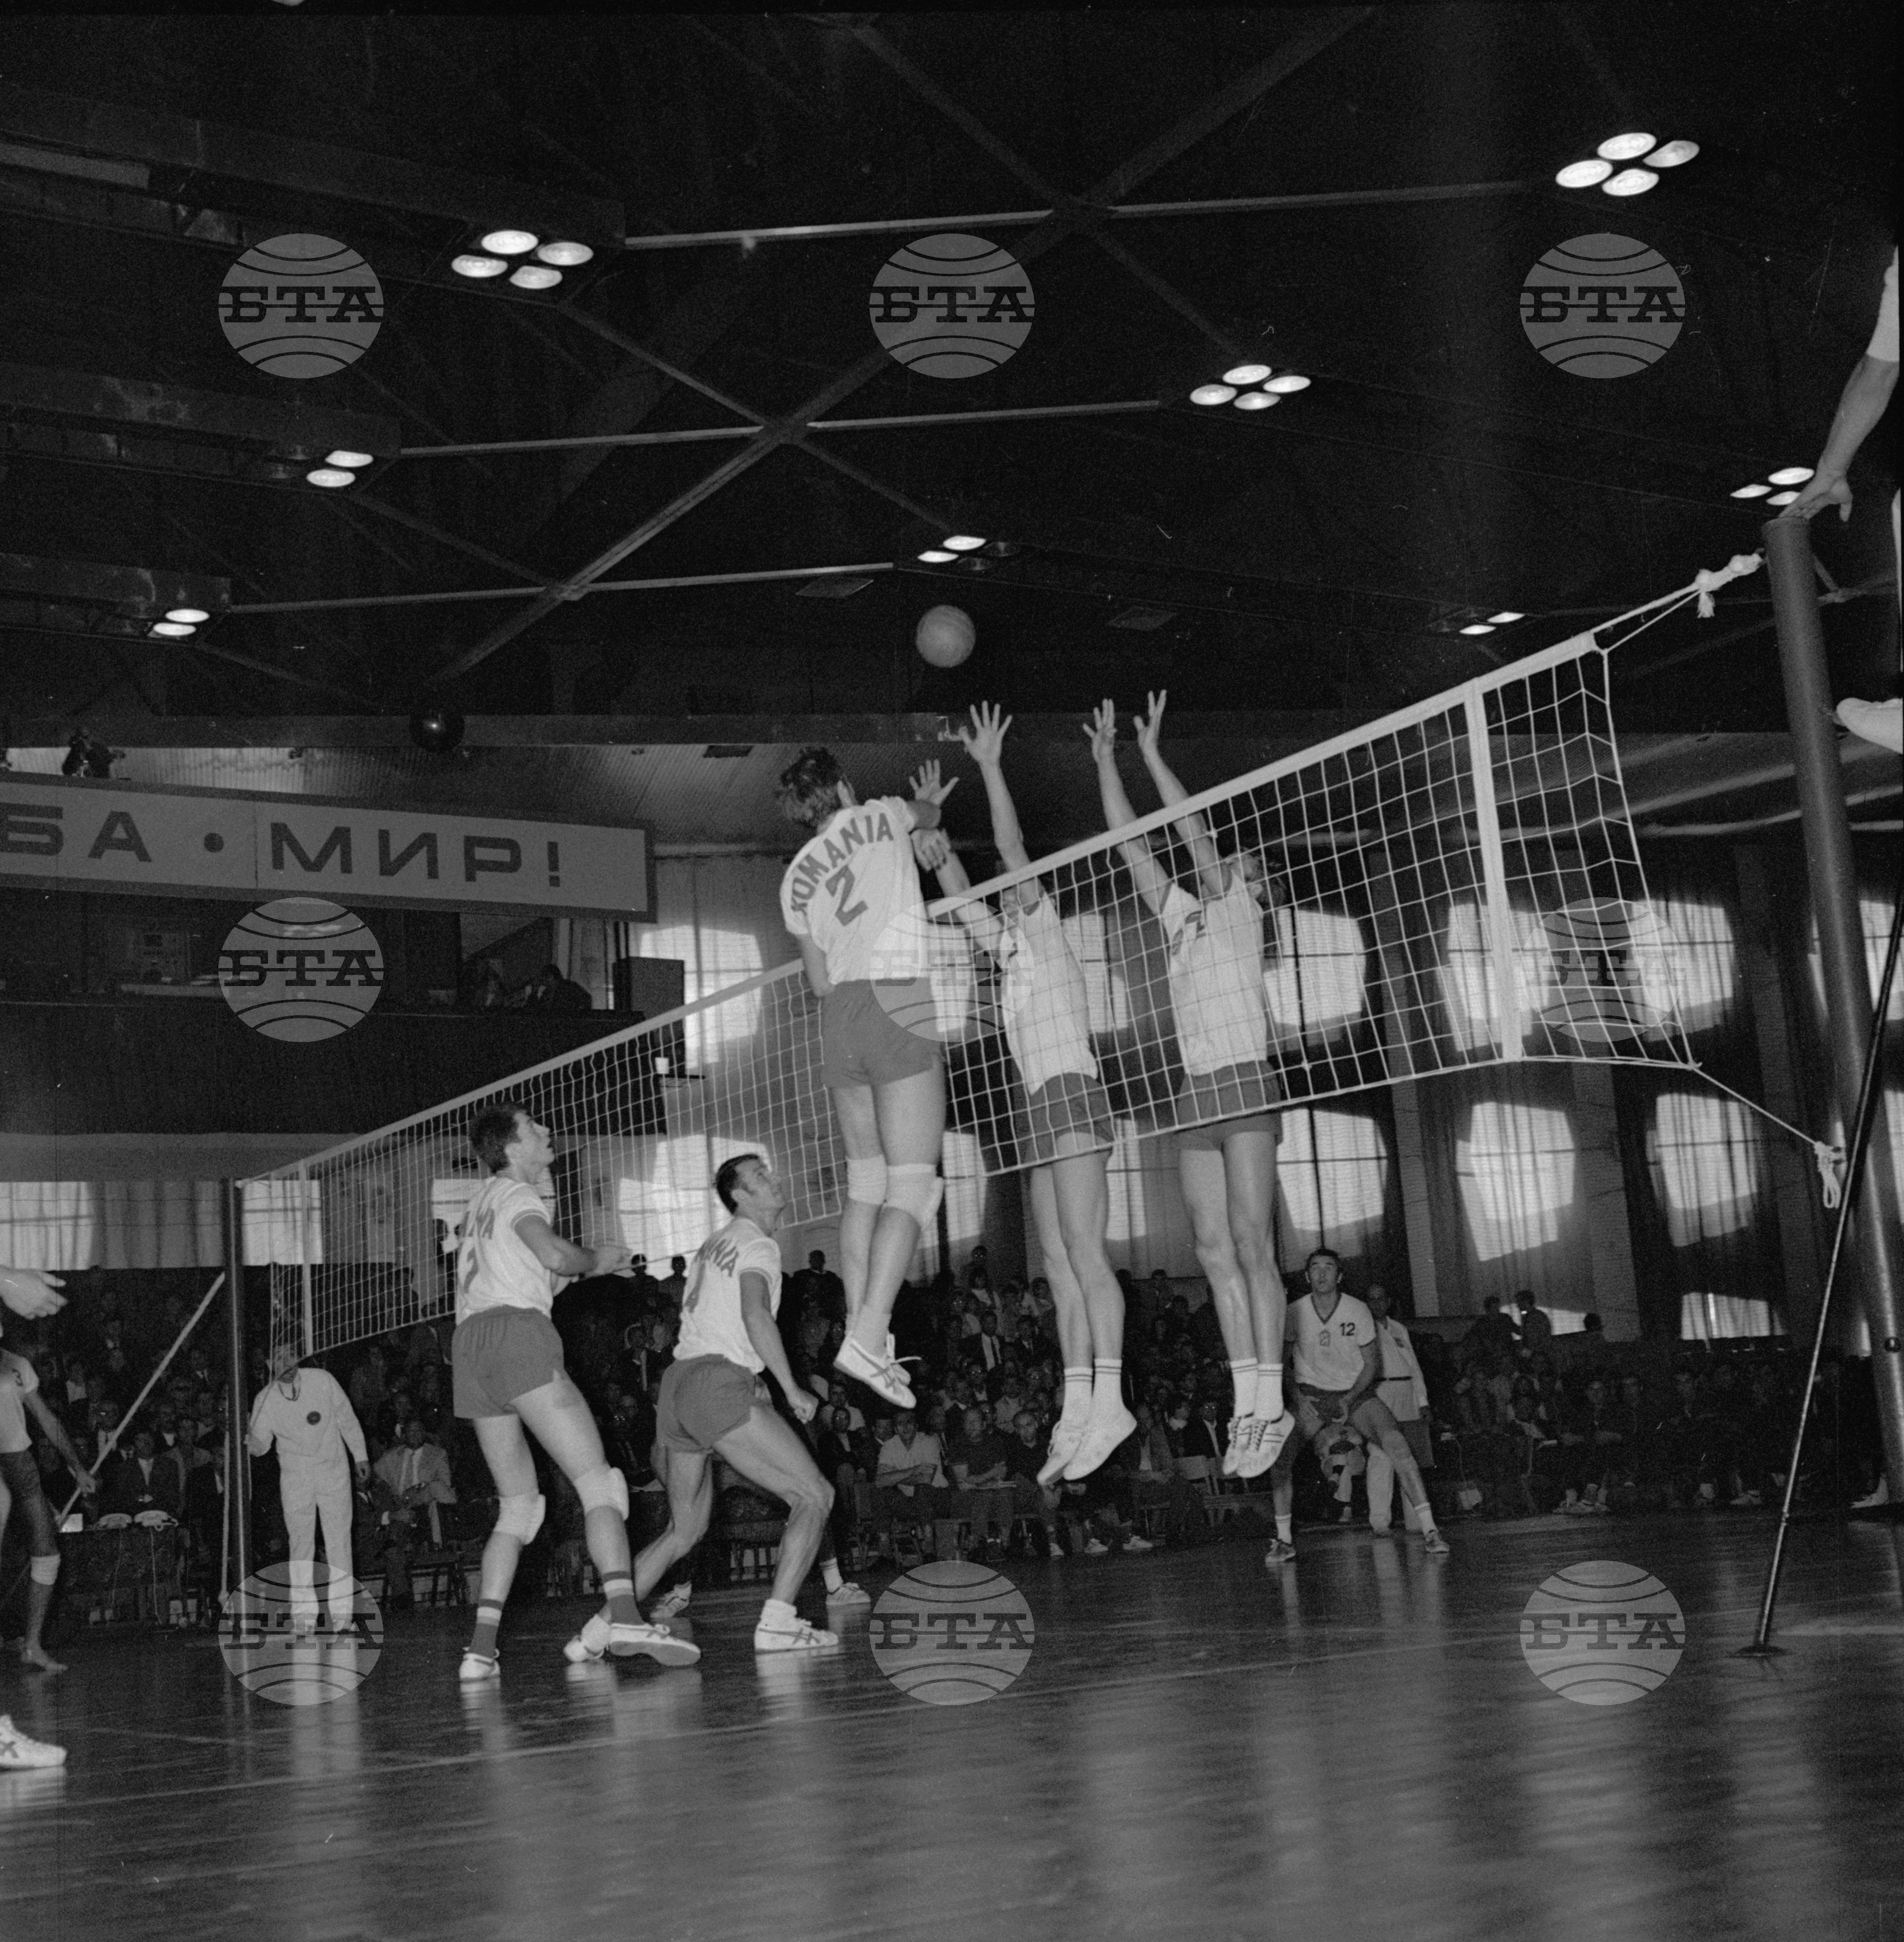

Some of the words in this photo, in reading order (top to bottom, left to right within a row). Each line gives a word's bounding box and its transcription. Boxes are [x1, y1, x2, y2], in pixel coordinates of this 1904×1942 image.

[0, 803, 152, 862] БА
[270, 822, 560, 887] МИР!
[825, 865, 868, 926] 2
[1340, 1322, 1356, 1336] 12
